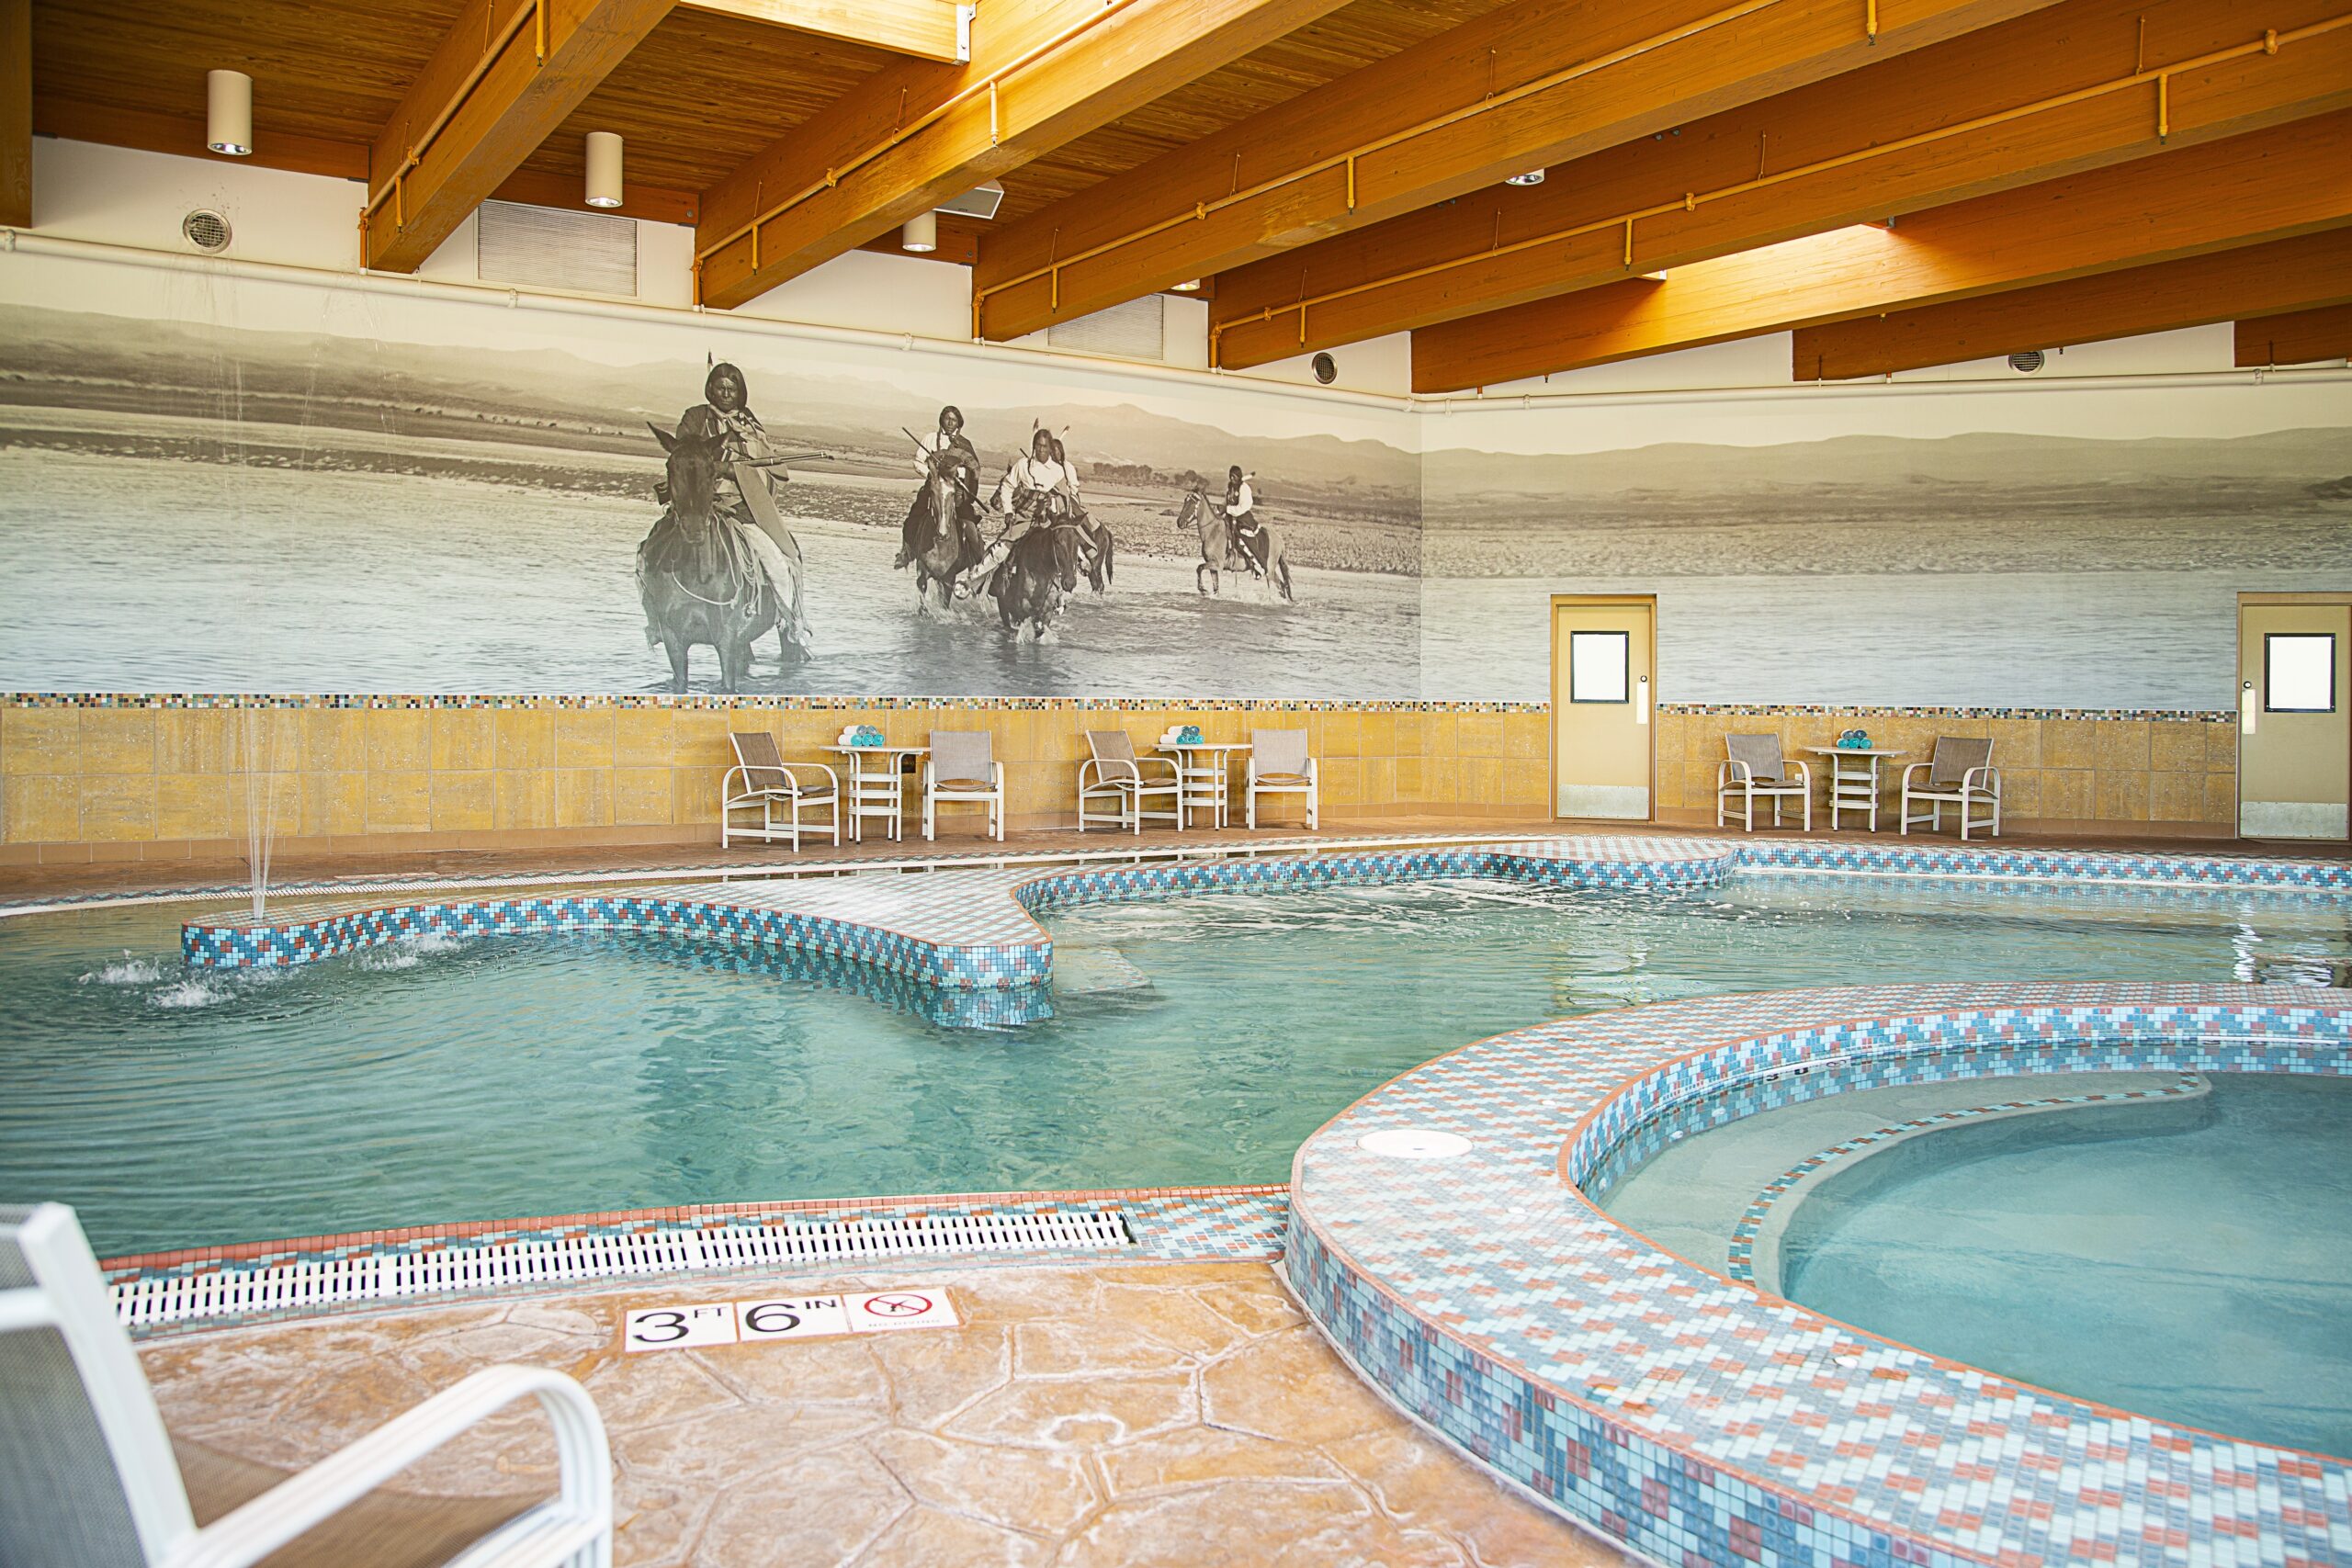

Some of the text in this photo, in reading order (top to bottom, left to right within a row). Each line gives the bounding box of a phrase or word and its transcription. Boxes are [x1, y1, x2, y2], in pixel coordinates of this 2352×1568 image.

[633, 1299, 838, 1343] 3 FT 6 IN
